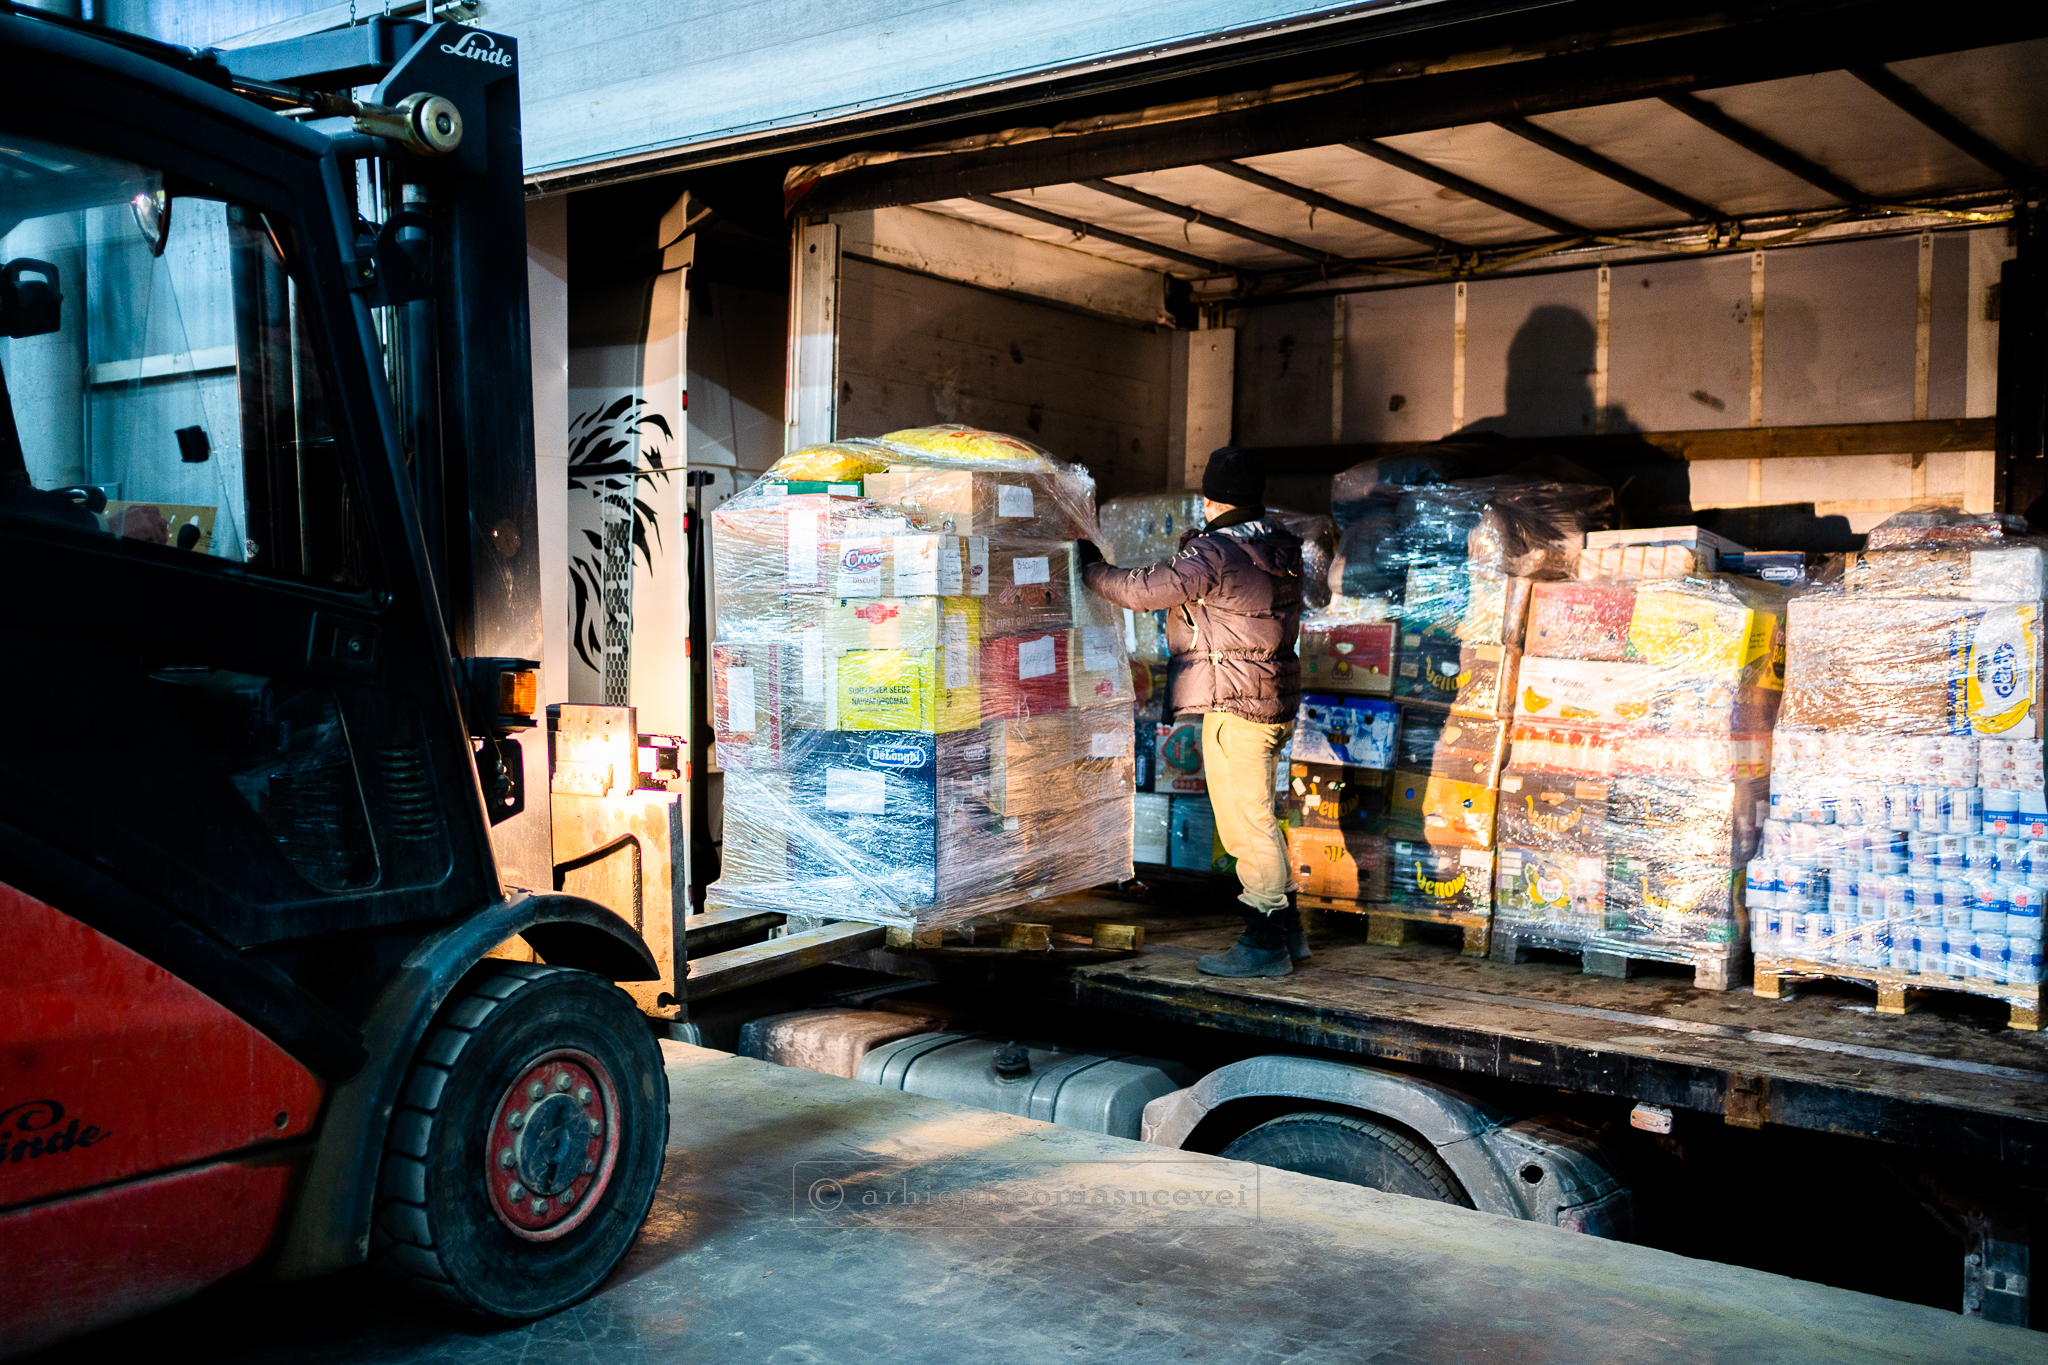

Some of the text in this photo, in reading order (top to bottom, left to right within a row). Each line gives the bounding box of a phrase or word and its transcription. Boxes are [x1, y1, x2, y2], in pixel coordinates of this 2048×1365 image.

[440, 31, 512, 67] Linde
[845, 550, 884, 569] Croco
[996, 618, 1014, 628] FIRST
[1425, 656, 1472, 691] yellow
[889, 685, 911, 694] SEEDS
[1414, 860, 1466, 898] yellow
